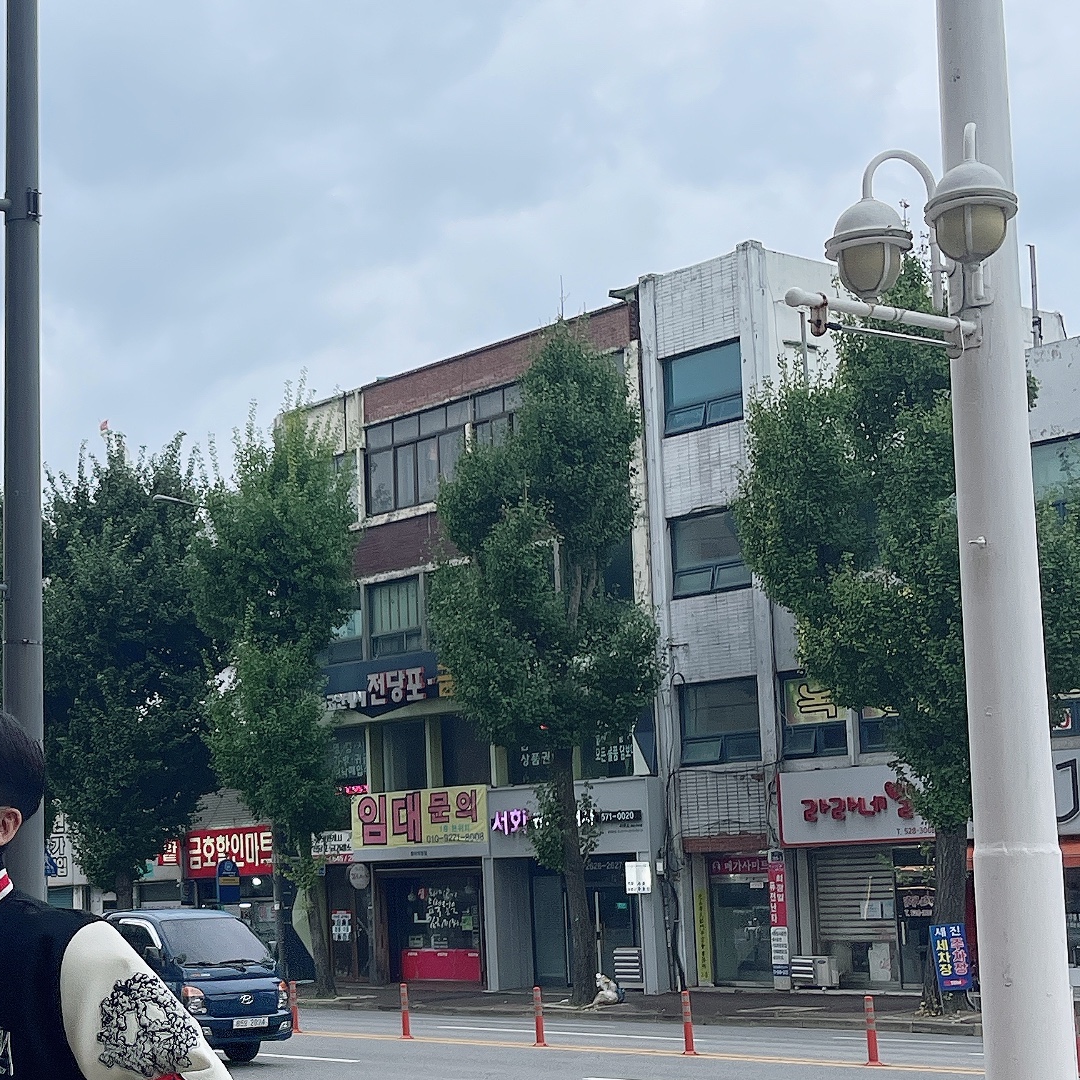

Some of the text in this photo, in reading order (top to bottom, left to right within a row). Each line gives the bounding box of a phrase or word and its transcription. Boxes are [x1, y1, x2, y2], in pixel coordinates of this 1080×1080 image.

[366, 666, 427, 706] 전당포
[358, 789, 477, 845] 임대 문의
[189, 831, 273, 870] 금호할인마트
[934, 926, 961, 938] 세진
[936, 939, 952, 976] 세차장
[950, 937, 968, 976] 주차장
